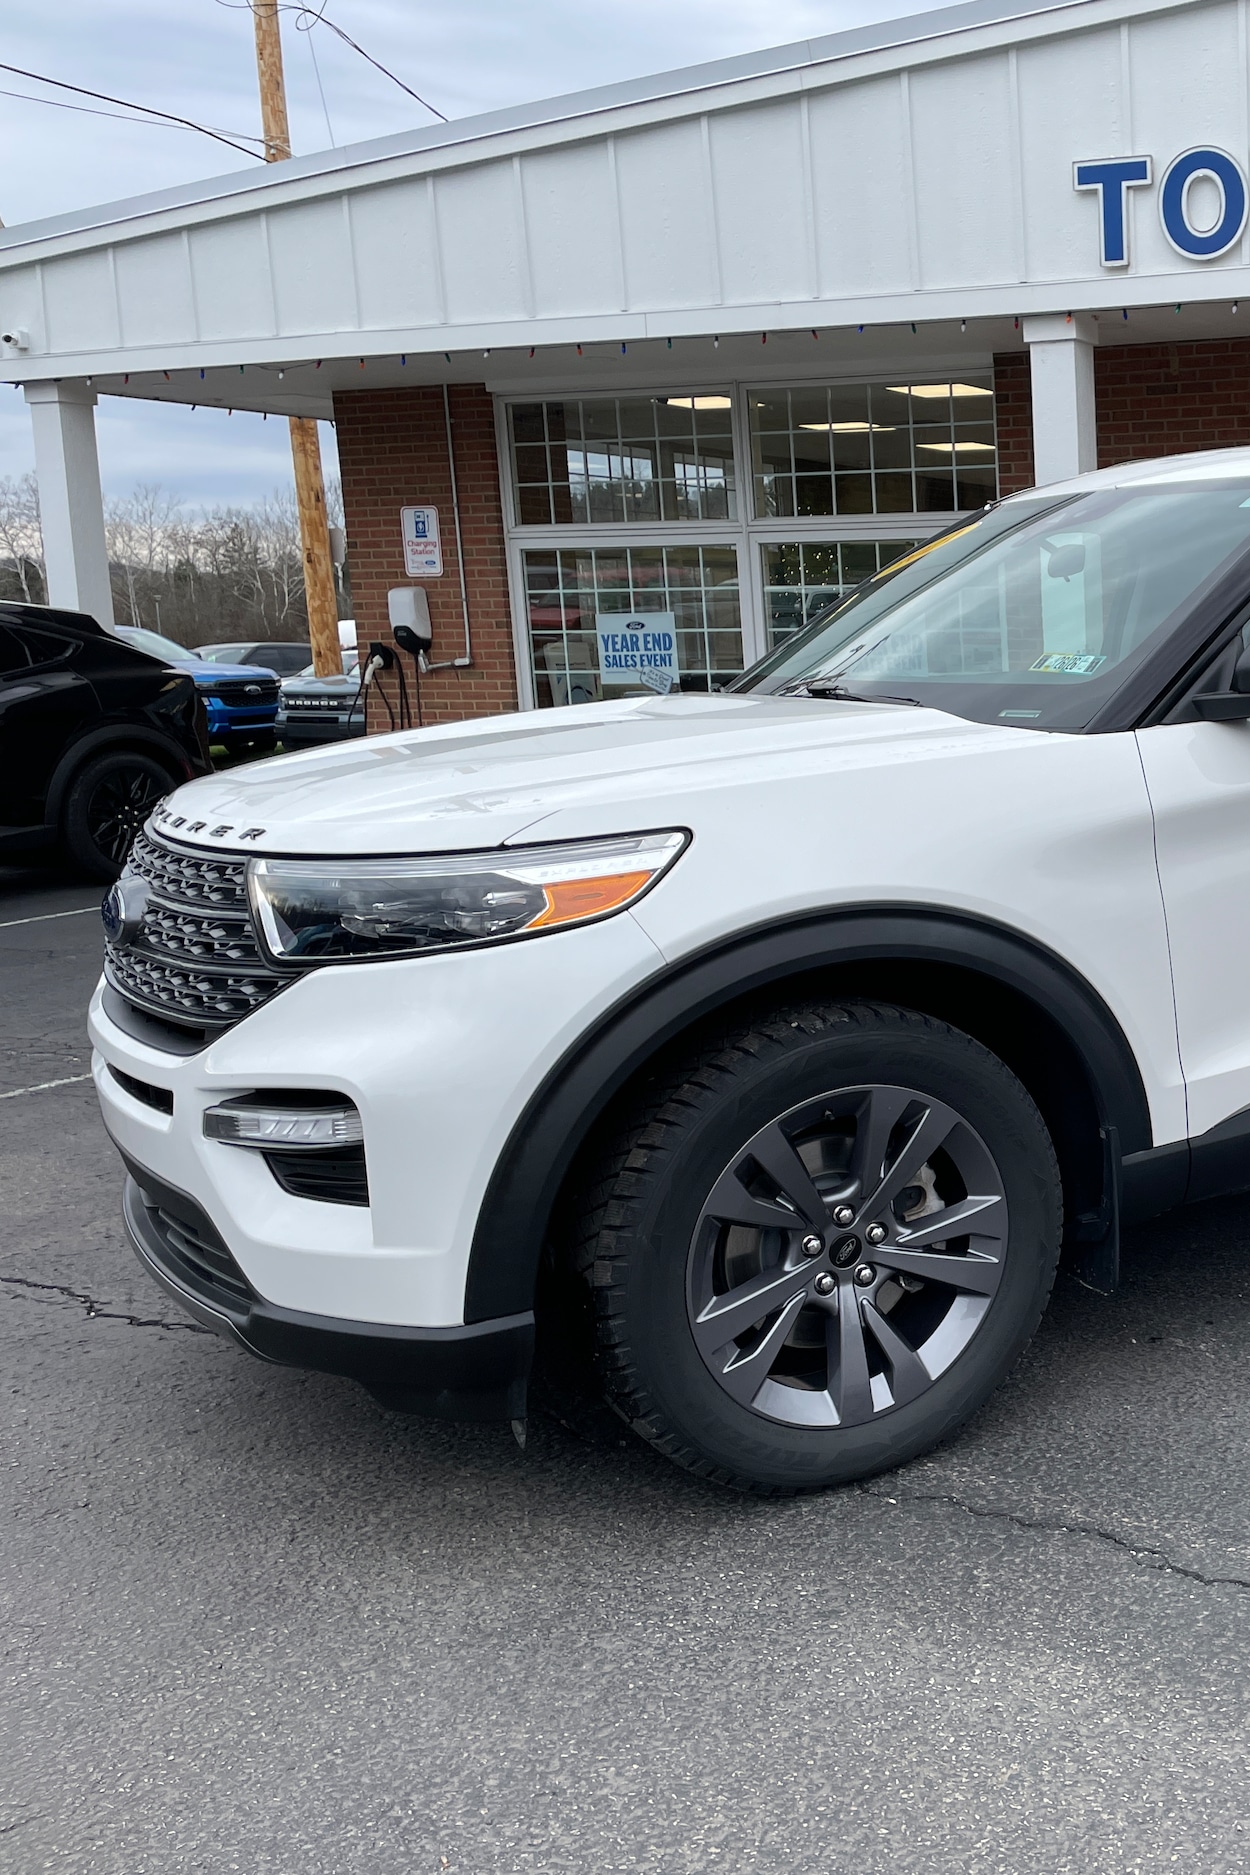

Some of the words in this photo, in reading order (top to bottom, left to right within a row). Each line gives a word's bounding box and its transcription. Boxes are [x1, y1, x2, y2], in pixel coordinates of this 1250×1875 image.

[407, 540, 437, 548] Charging
[411, 548, 436, 556] Station
[601, 633, 640, 653] YEAR
[643, 632, 673, 652] END
[604, 653, 638, 669] SALES
[639, 652, 673, 668] EVENT
